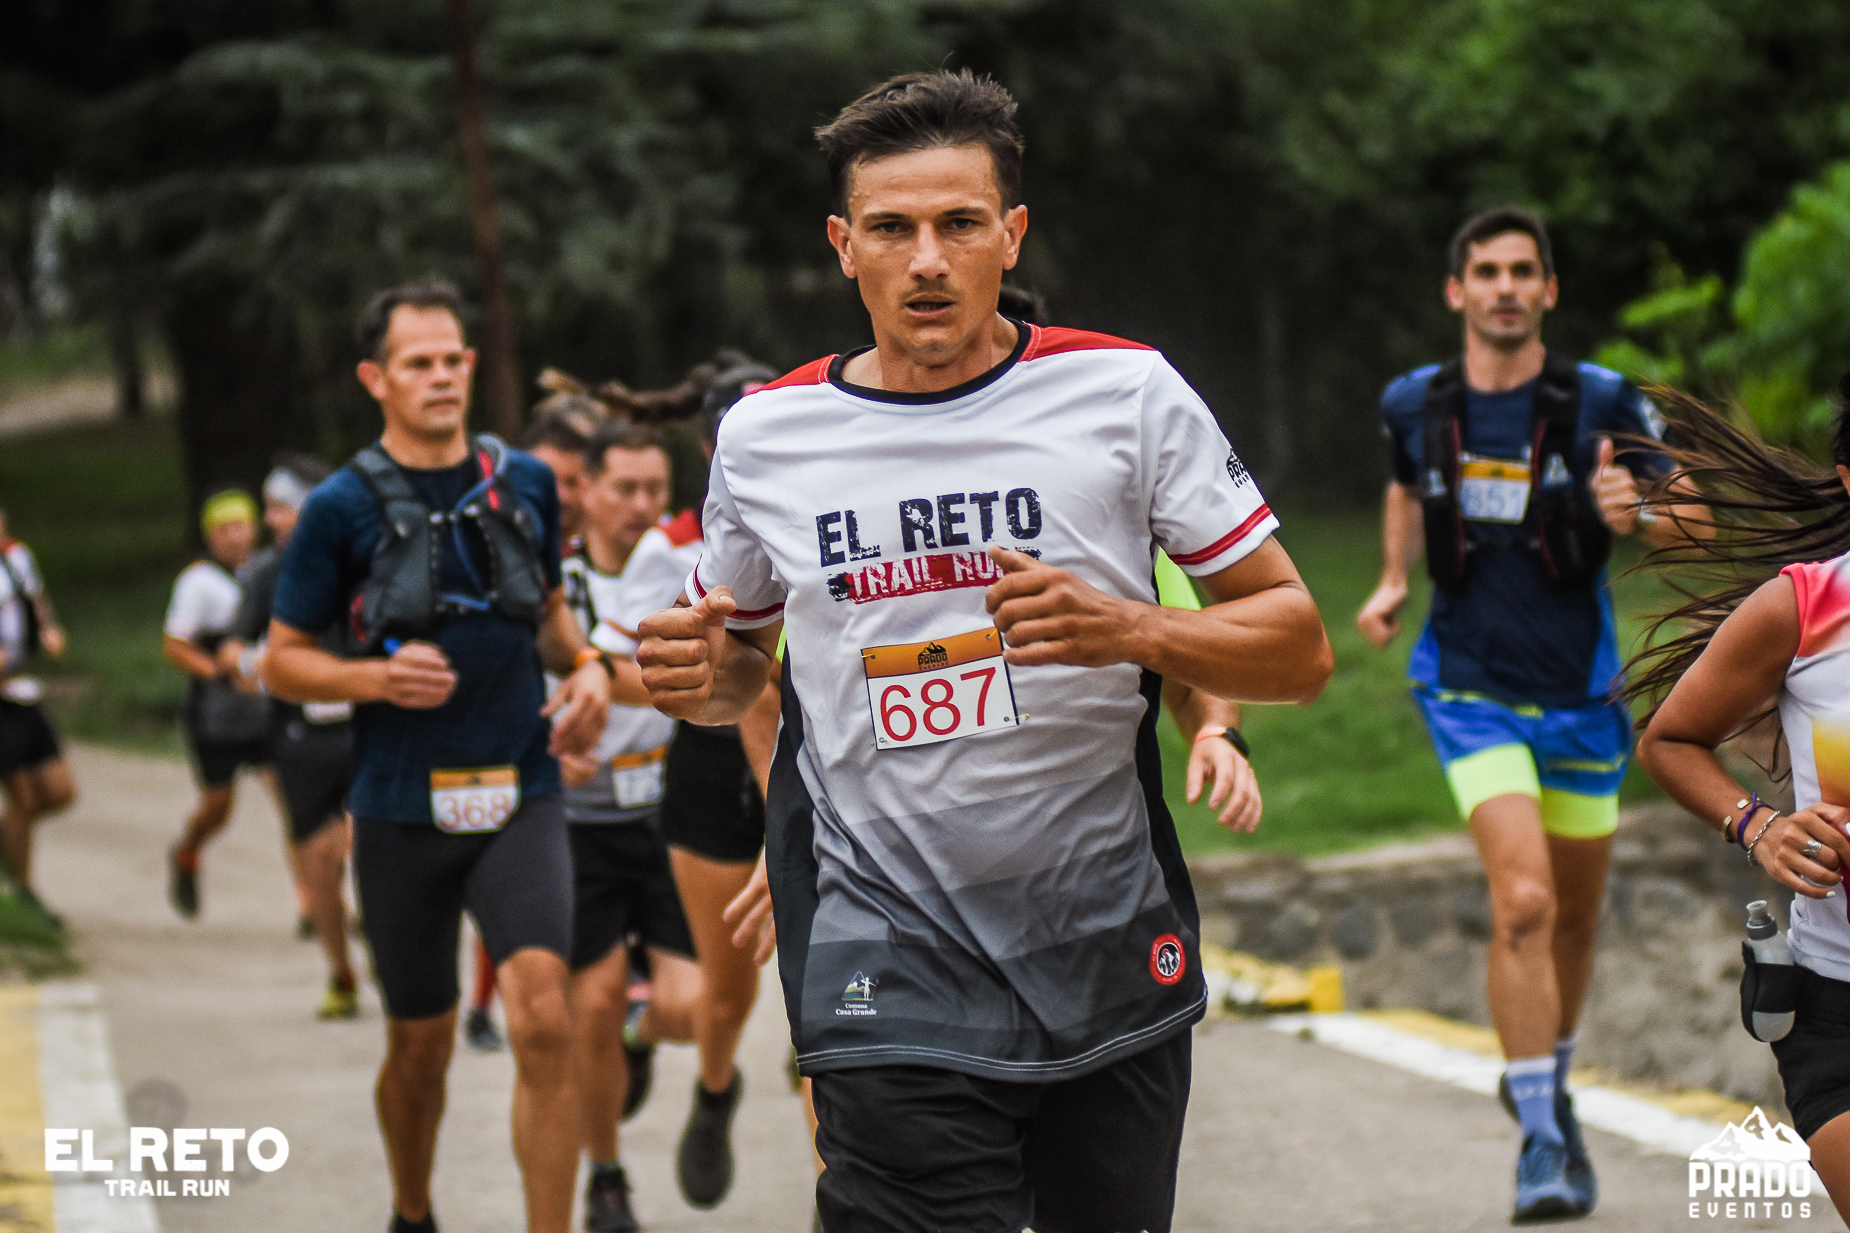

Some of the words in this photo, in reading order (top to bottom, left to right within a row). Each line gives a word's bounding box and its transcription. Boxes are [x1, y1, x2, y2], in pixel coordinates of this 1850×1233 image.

[816, 510, 881, 567] EL
[899, 487, 1042, 551] RETO
[853, 556, 944, 598] TRAIL
[953, 551, 1005, 582] RU
[918, 653, 948, 666] PRADO
[880, 667, 996, 742] 687
[439, 793, 510, 828] 368
[835, 1008, 852, 1016] Casa
[852, 1008, 877, 1016] Grande
